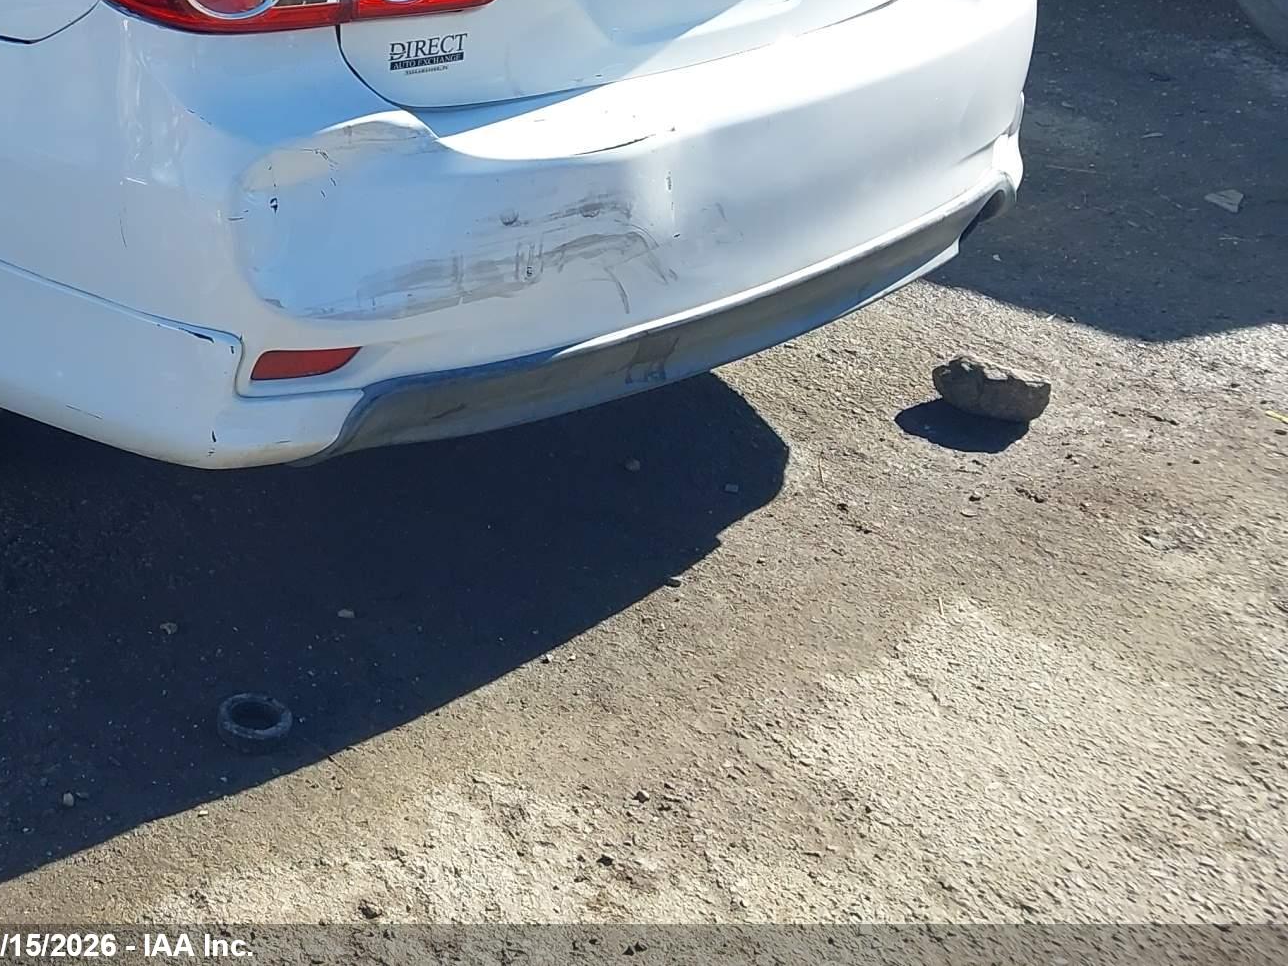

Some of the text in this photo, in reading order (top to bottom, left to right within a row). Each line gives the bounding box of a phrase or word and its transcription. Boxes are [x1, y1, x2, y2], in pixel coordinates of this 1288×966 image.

[388, 32, 468, 62] DIRECT
[392, 59, 416, 70] AUTO
[417, 52, 462, 67] EXCHANGE
